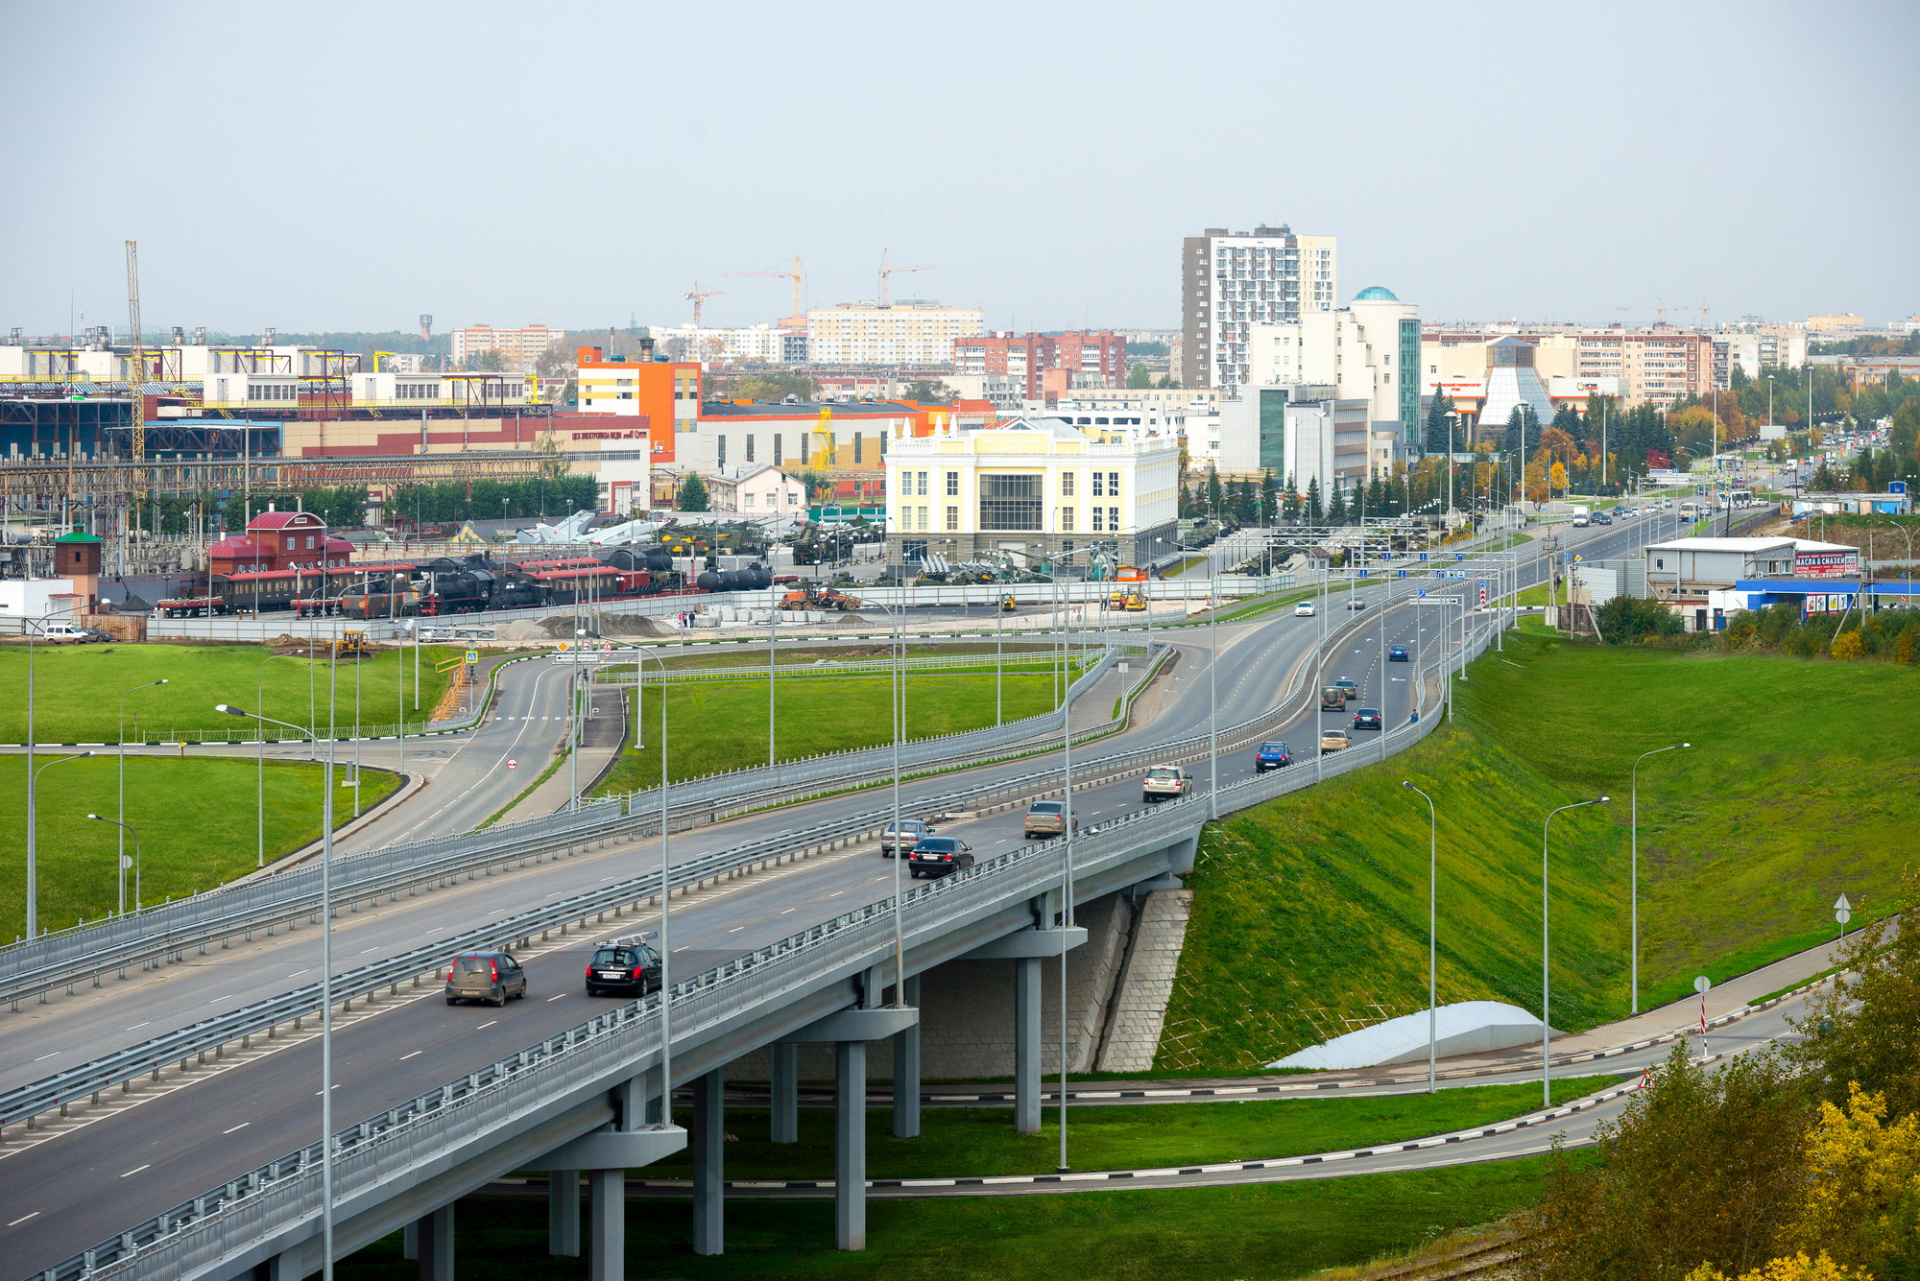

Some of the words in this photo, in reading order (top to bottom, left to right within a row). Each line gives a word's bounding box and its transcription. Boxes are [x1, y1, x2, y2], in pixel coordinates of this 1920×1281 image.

[1796, 558, 1816, 566] МАСЛА
[1816, 557, 1821, 565] &
[1821, 556, 1845, 564] СМАЗКИ
